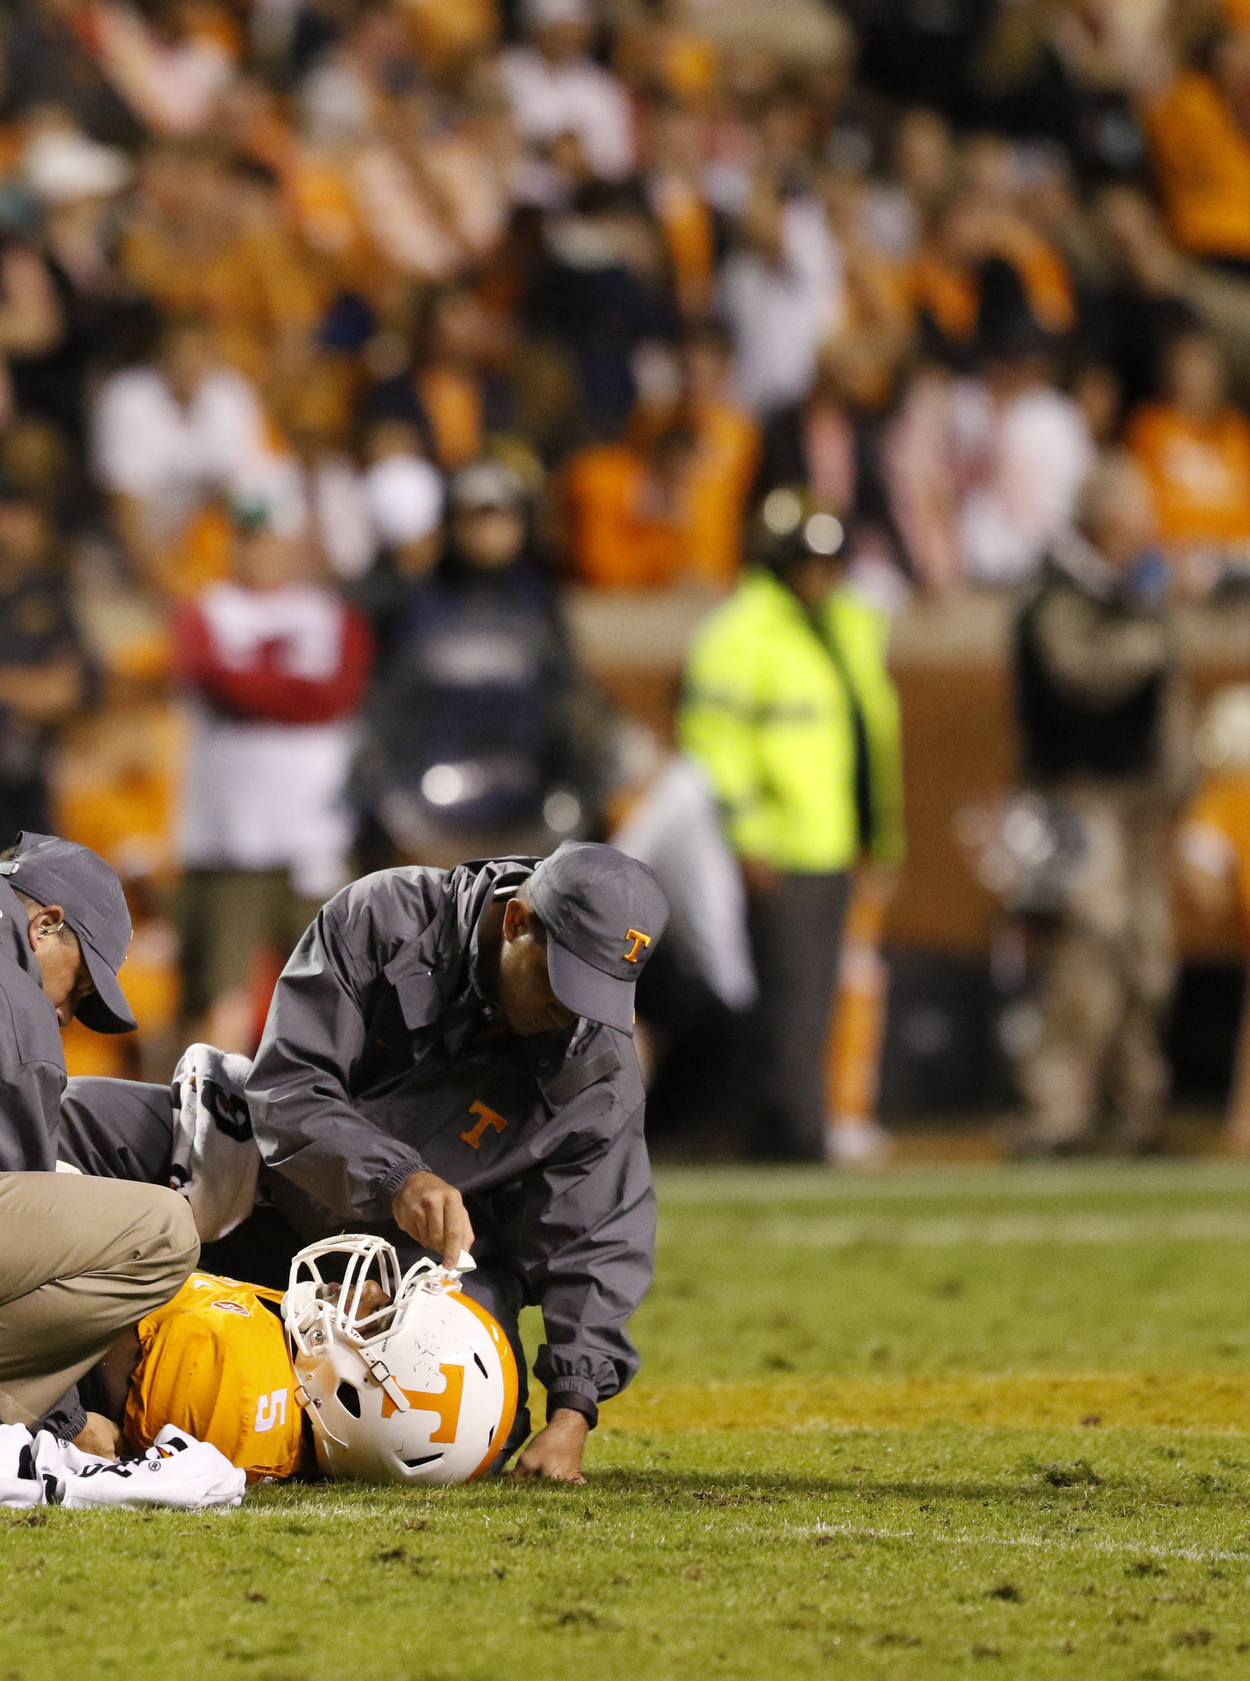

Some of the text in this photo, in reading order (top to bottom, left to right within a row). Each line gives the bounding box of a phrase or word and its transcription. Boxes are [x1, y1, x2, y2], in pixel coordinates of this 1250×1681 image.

[623, 929, 651, 963] T
[460, 1101, 507, 1148] T
[254, 1388, 287, 1432] 5
[381, 1363, 465, 1443] T
